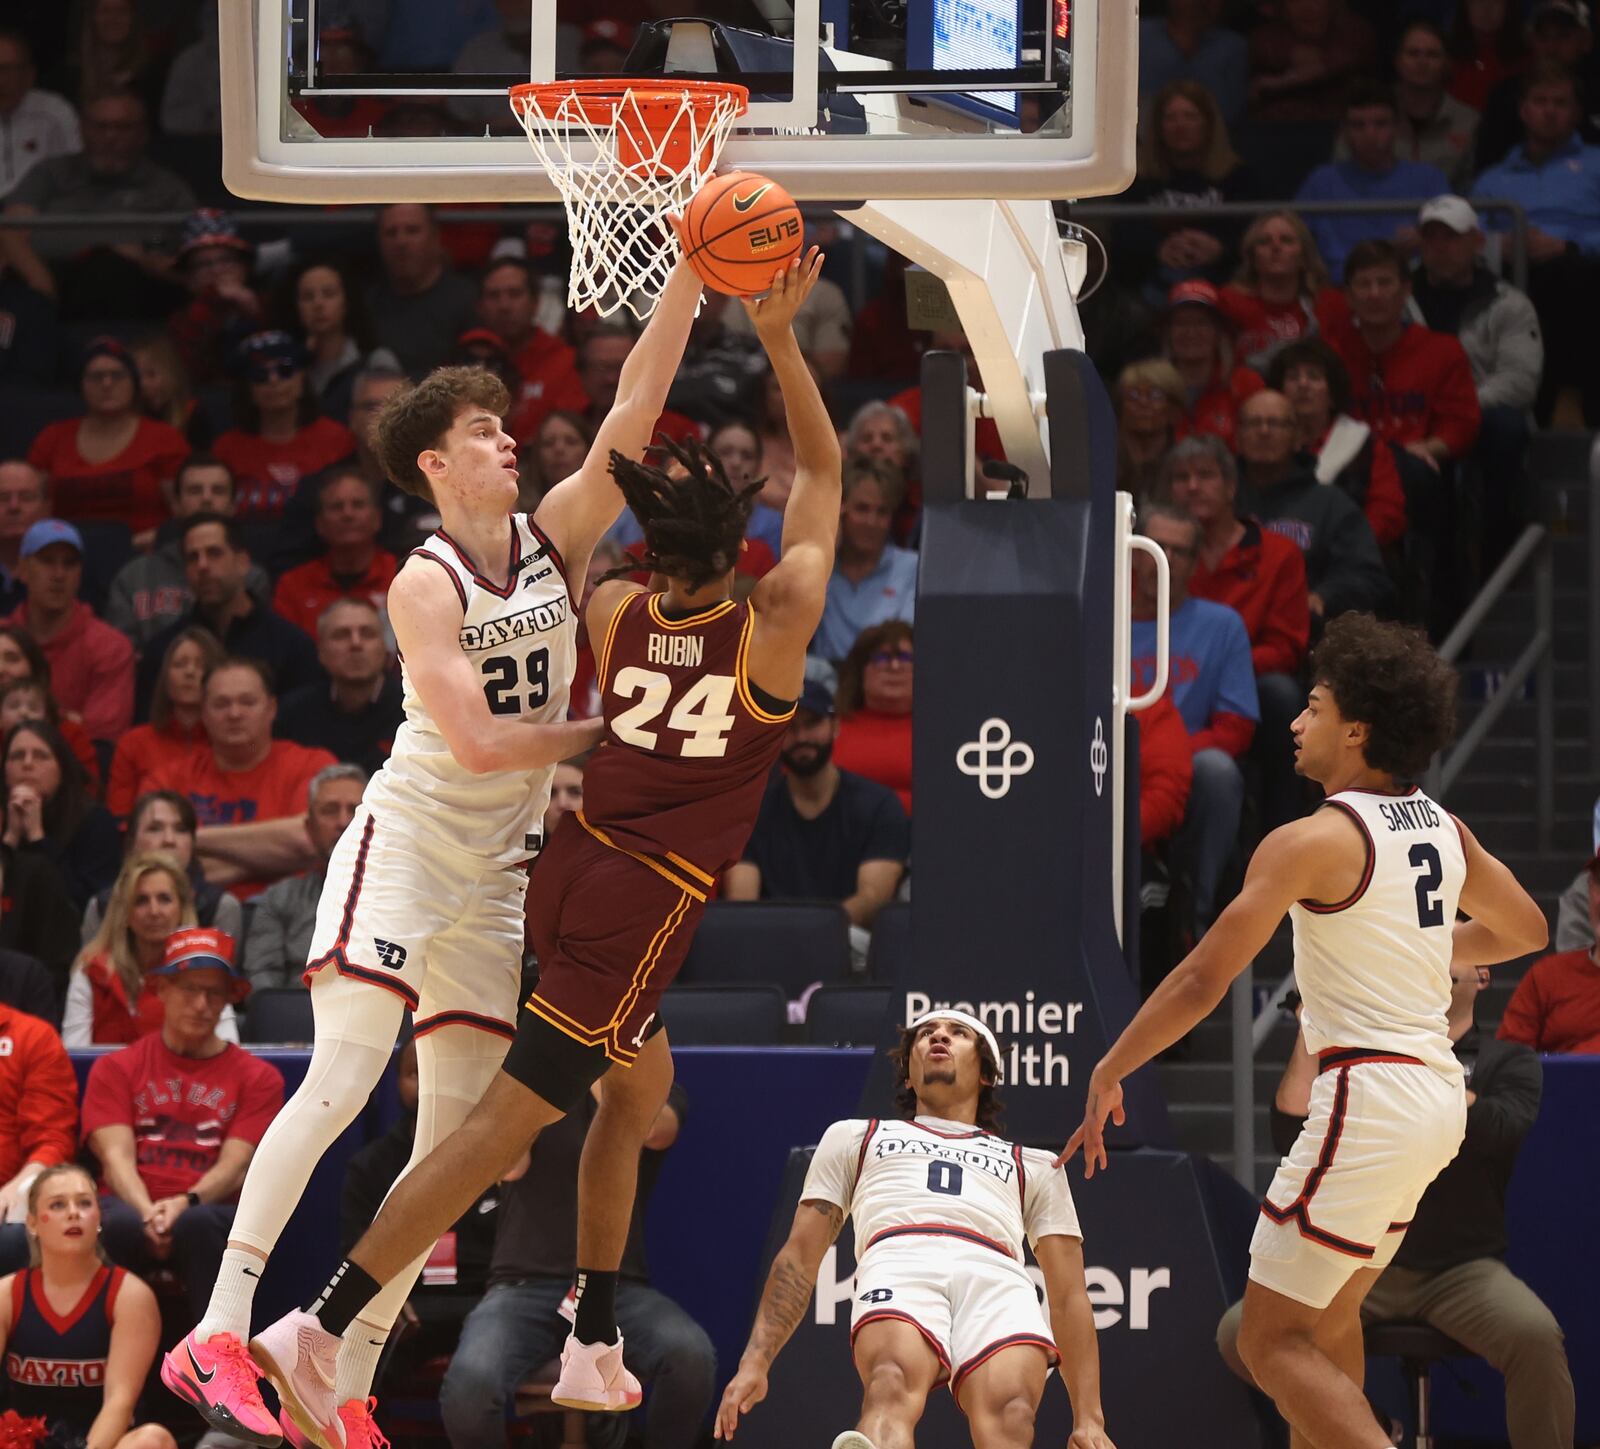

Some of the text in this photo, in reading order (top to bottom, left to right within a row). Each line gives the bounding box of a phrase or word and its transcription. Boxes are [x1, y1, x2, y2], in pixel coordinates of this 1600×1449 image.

[748, 217, 800, 248] ELITE
[523, 567, 552, 590] A10
[524, 553, 540, 566] DJD
[459, 595, 567, 651] DAYTON
[648, 633, 704, 667] RUBIN
[482, 647, 549, 714] 29
[610, 666, 737, 757] 24
[1379, 799, 1440, 831] SANTOS
[1408, 842, 1444, 928] 2
[906, 990, 1083, 1034] Pmier
[134, 1078, 237, 1121] FLYERS
[876, 1138, 1013, 1184] DAYTON
[927, 1159, 963, 1196] 0
[7, 1352, 106, 1387] DAYTO
